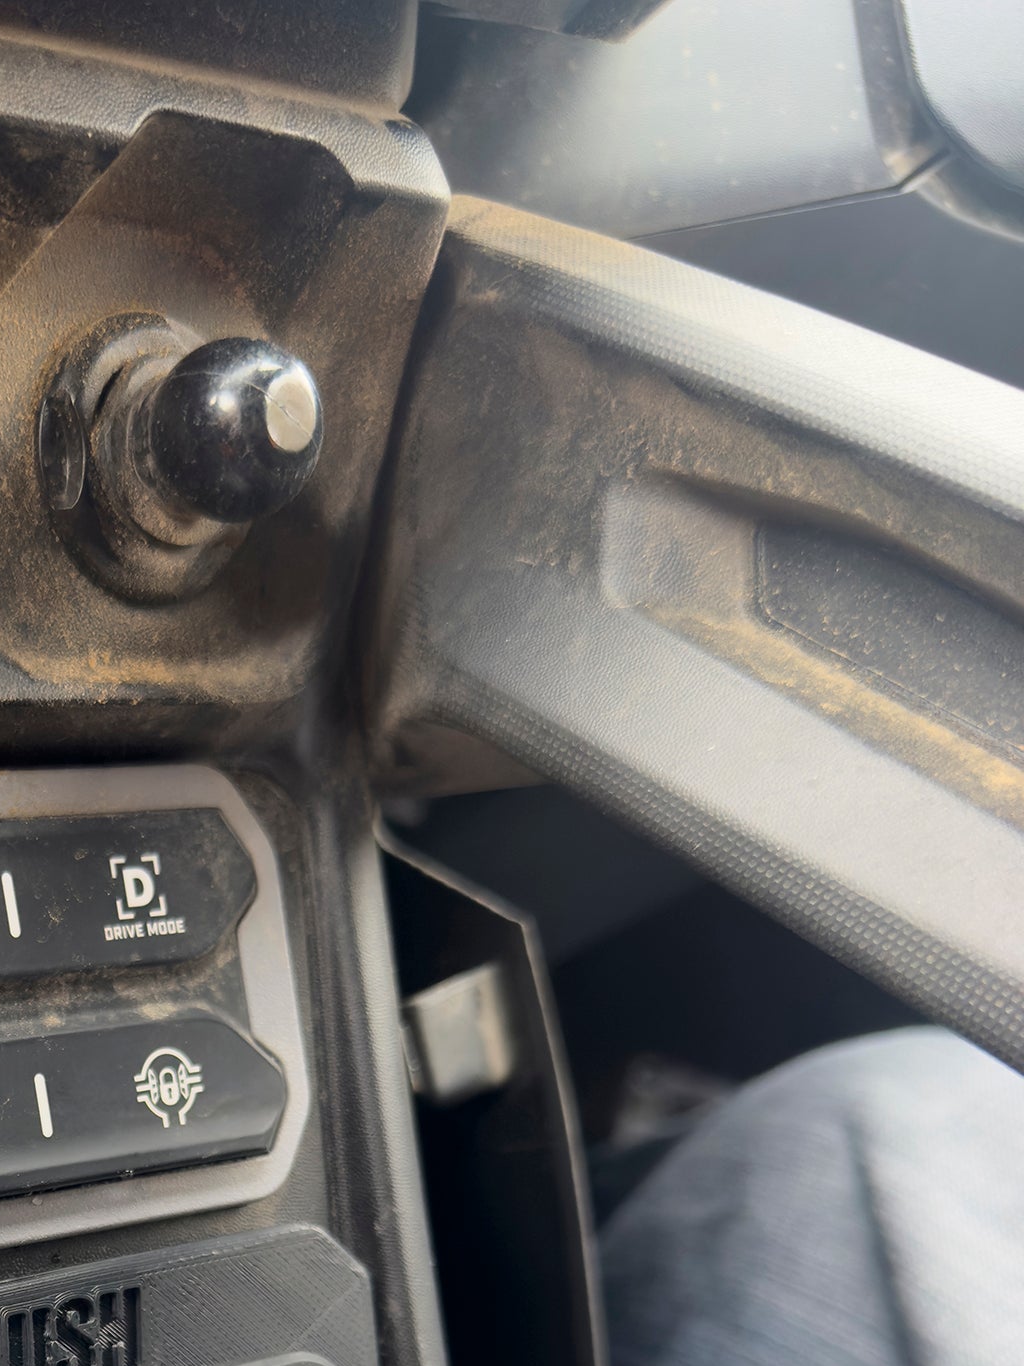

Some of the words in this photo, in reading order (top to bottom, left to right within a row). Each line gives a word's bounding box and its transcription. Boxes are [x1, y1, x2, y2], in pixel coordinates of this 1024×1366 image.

[122, 867, 155, 908] D
[104, 923, 145, 941] DRIVE
[146, 919, 186, 937] MODE
